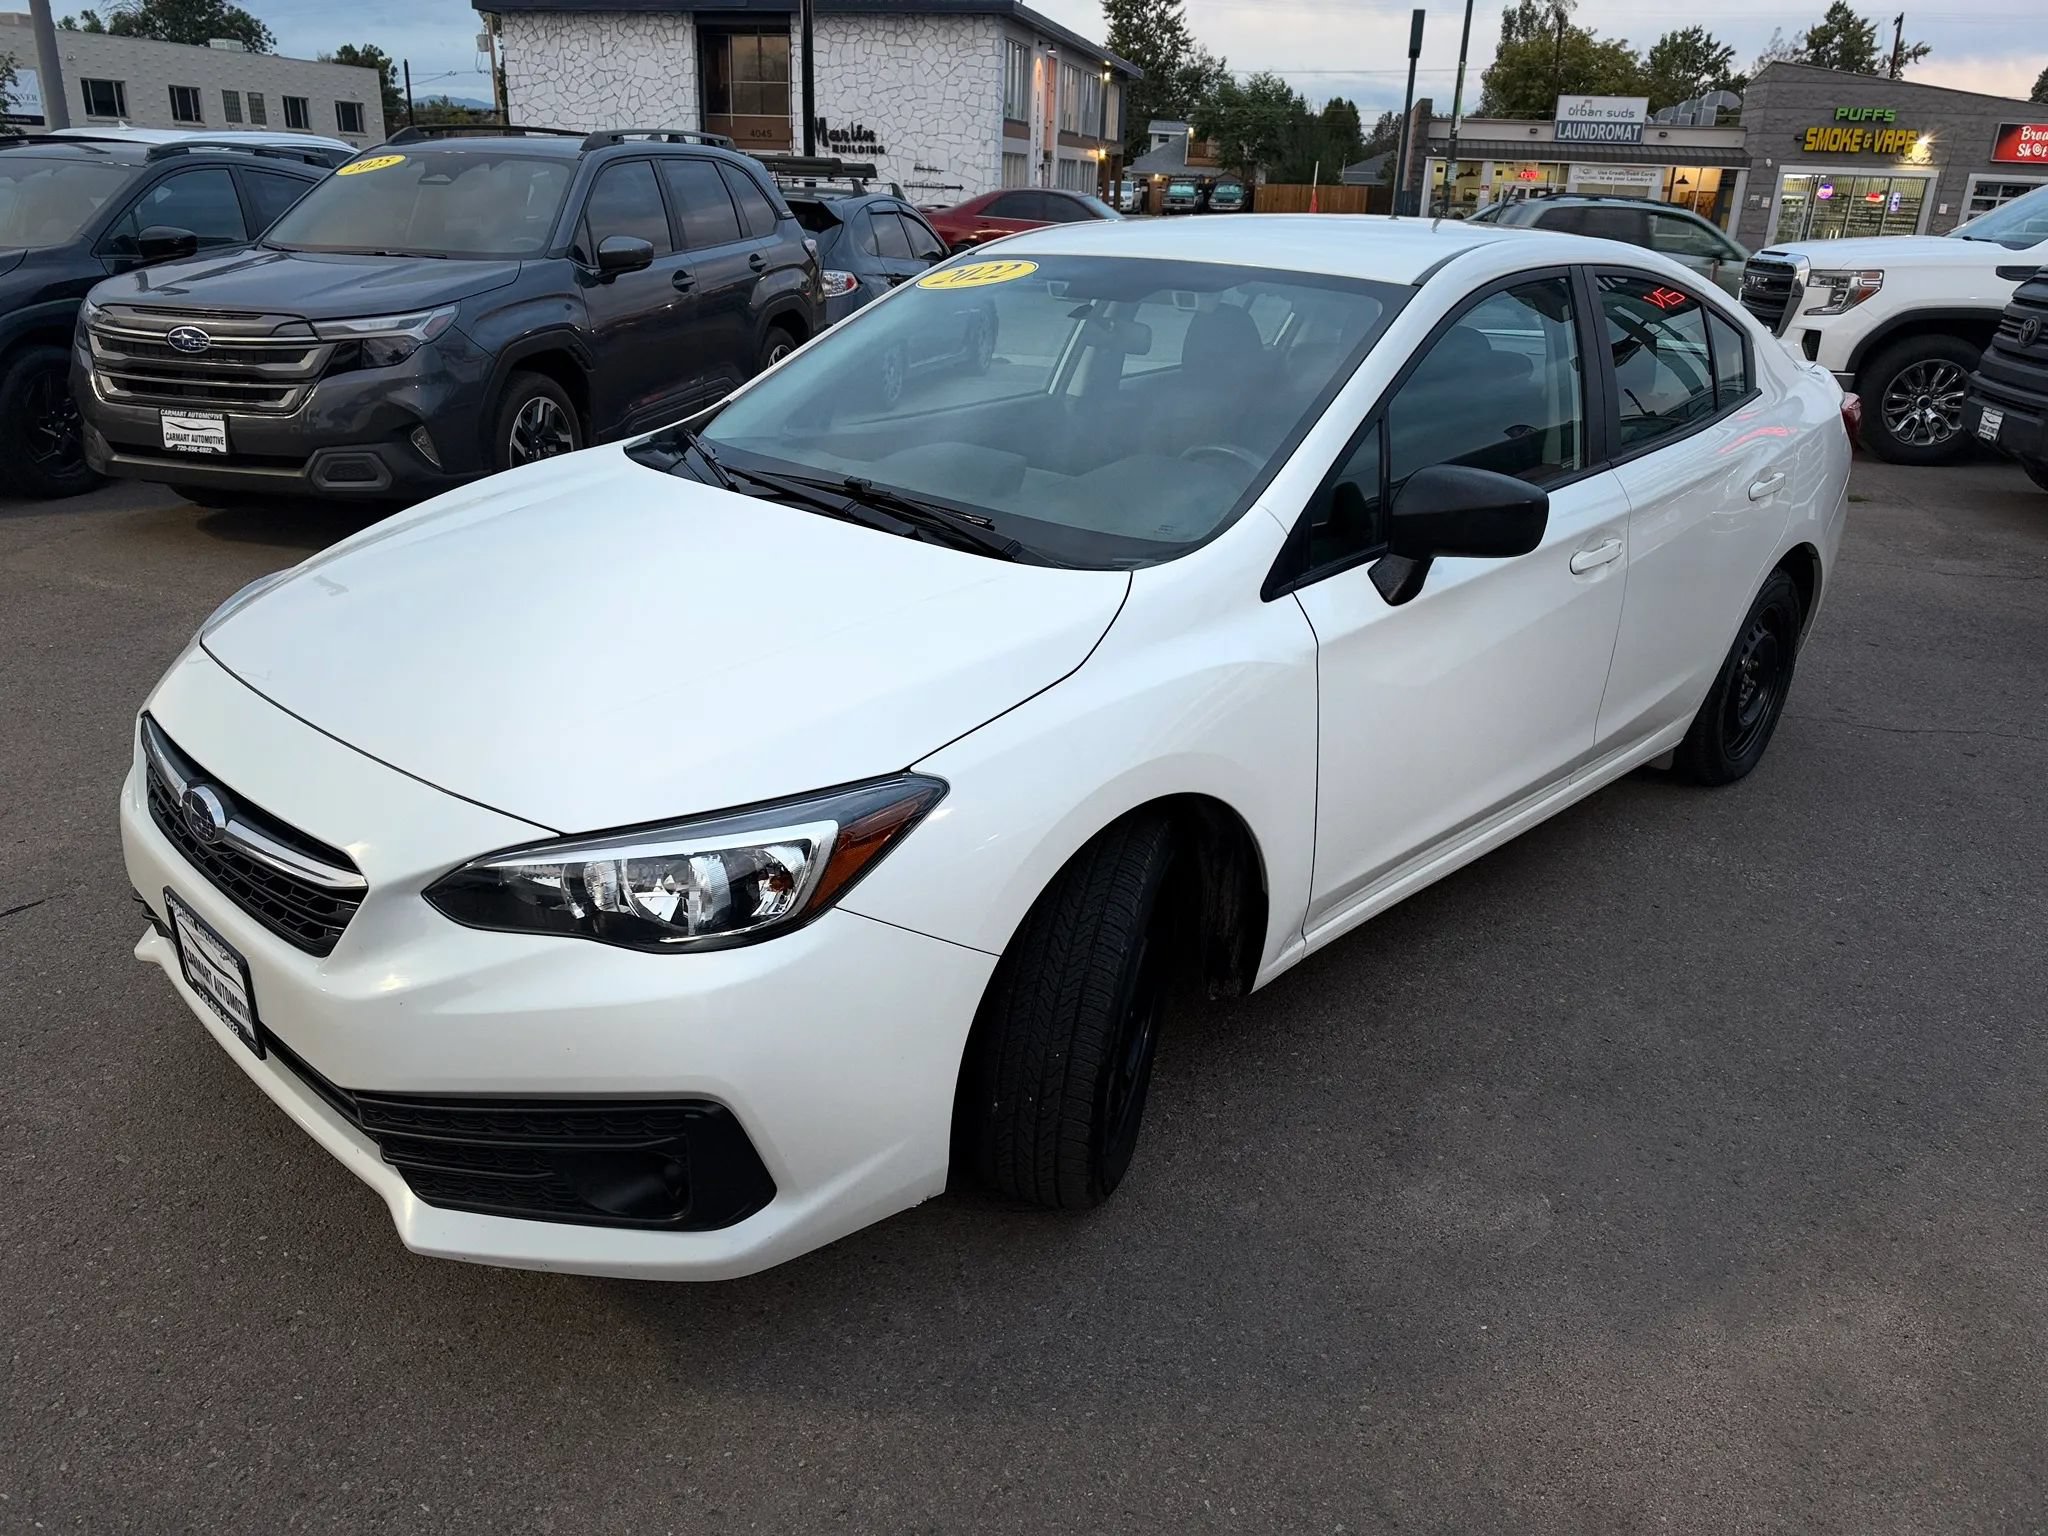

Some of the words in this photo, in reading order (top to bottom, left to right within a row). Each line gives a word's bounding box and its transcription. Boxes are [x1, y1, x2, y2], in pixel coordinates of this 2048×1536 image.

[1606, 109, 1635, 119] suds
[1835, 107, 1896, 122] PUFFS
[750, 128, 773, 138] 4045
[814, 116, 876, 148] Marlin
[1557, 122, 1641, 141] LAUNDROMAT
[1803, 127, 1864, 153] SMOKE
[1862, 132, 1873, 149] &
[1872, 128, 1919, 155] VAPE
[831, 144, 886, 154] BUILDING
[928, 263, 1023, 285] 2022
[160, 409, 187, 418] CARMART
[187, 411, 223, 420] AUTOMOTIVE
[166, 432, 190, 441] CARMART
[191, 434, 224, 445] AUTOMOTIVE
[184, 944, 214, 989] CARMART
